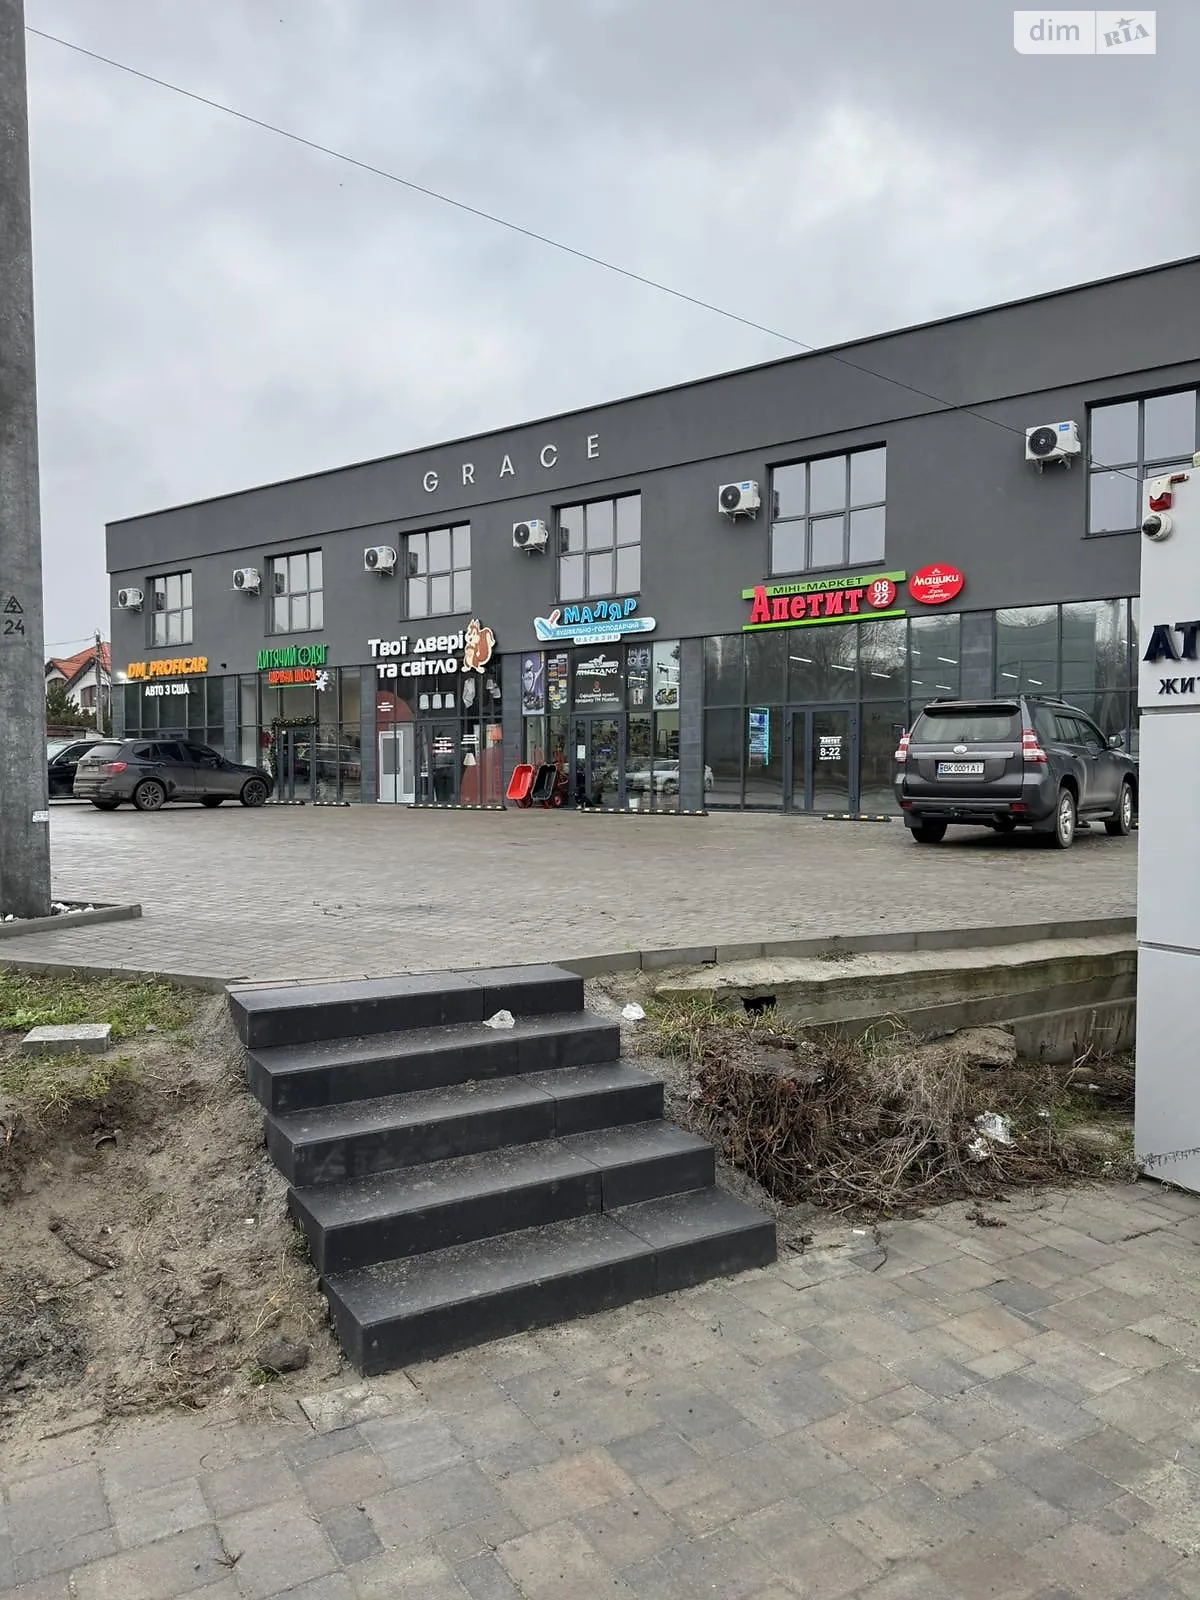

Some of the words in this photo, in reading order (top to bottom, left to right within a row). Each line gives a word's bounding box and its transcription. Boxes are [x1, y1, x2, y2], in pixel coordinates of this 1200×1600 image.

[423, 434, 600, 492] GRACE
[773, 577, 864, 595] МІНІ-МАРКЕТ
[873, 581, 889, 593] 08
[750, 585, 863, 624] Апетит
[873, 593, 889, 605] 22
[563, 598, 637, 624] МАЛЯР
[3, 619, 25, 636] 24
[367, 635, 407, 657] Твої
[413, 630, 464, 655] двері
[127, 655, 208, 680] DM_PROFICAR
[376, 664, 397, 679] та
[401, 657, 458, 677] світло
[145, 684, 164, 697] АВТО
[171, 683, 190, 695] США
[1158, 676, 1200, 694] ЖИ
[820, 746, 841, 756] 8-22
